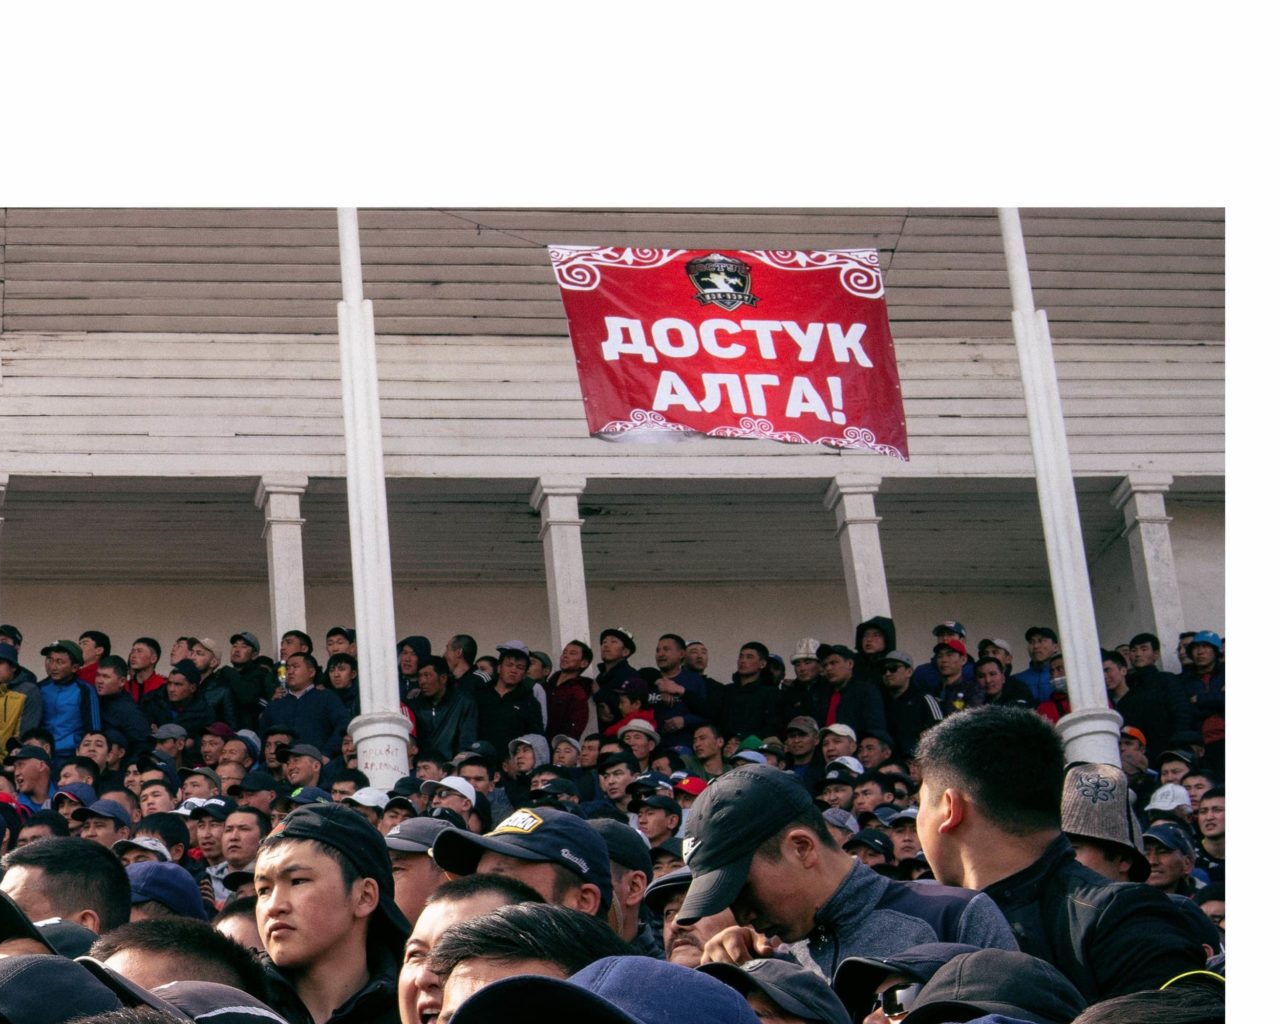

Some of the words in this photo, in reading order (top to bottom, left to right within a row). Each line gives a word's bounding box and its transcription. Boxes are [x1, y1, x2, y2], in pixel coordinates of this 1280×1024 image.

[601, 315, 874, 368] ДОСТУК
[652, 370, 847, 425] АЛГА!
[560, 848, 591, 874] Quality
